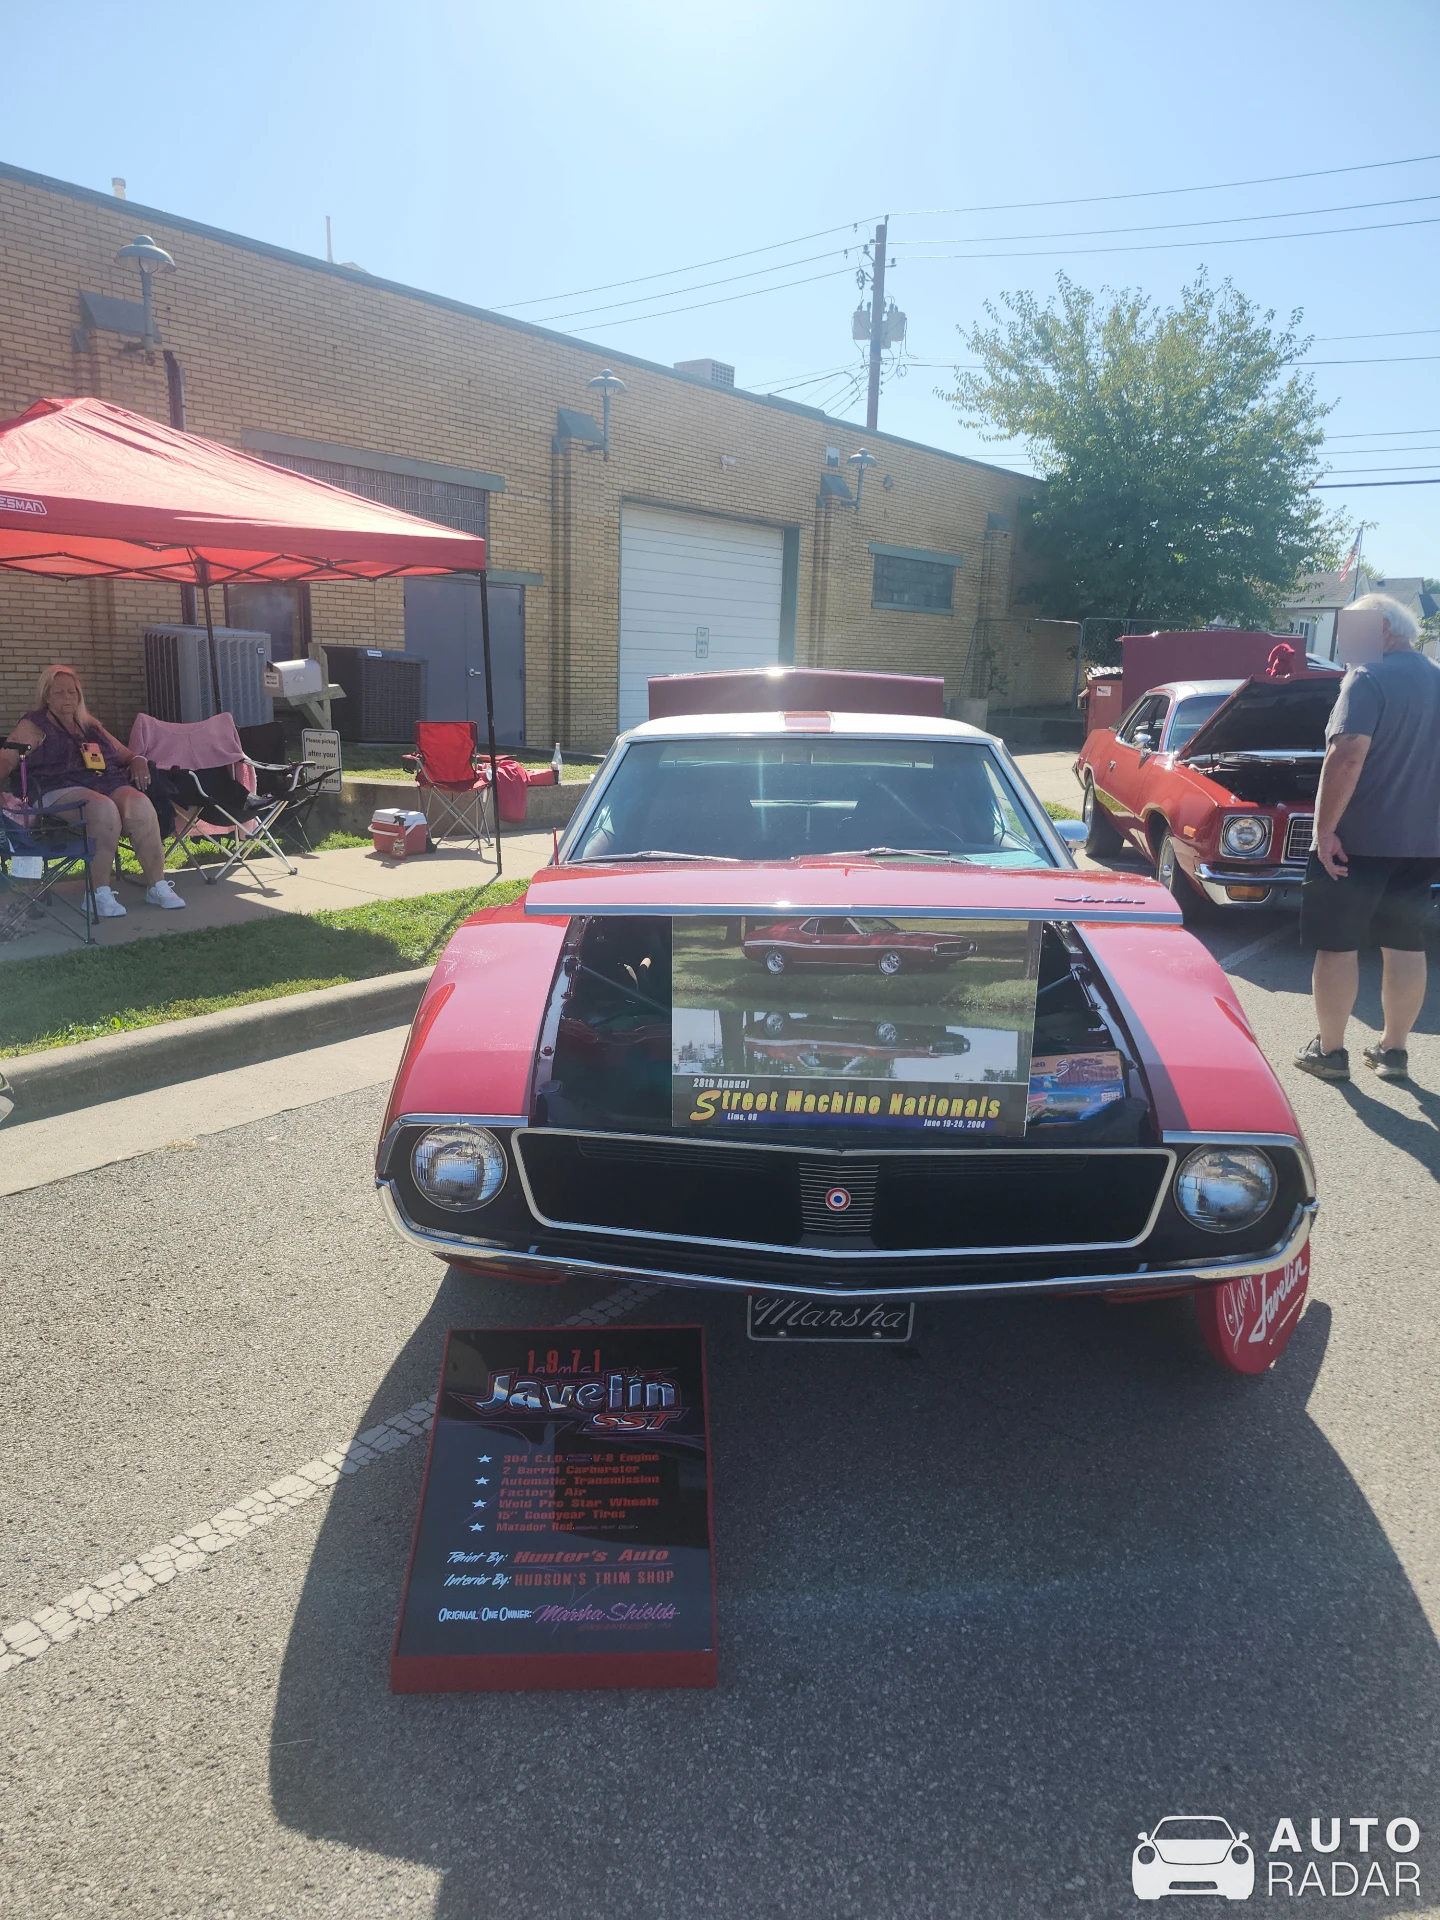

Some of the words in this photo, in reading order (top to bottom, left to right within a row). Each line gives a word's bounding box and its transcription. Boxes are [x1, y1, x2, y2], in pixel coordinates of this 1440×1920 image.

[322, 738, 336, 746] pickup
[692, 1078, 714, 1088] 28th
[716, 1078, 750, 1089] Annual
[689, 1090, 778, 1121] Street
[785, 1090, 881, 1115] Machine
[888, 1093, 1000, 1119] Nationals
[924, 1118, 941, 1128] June
[942, 1120, 965, 1129] 19-20,
[966, 1120, 986, 1129] 2004
[1248, 1256, 1308, 1344] Javelin
[754, 1297, 906, 1328] Marsha
[527, 1350, 600, 1373] 1971
[475, 1374, 676, 1410] Javelin
[588, 1412, 681, 1432] SST
[504, 1454, 528, 1463] 304
[592, 1454, 614, 1462] V-8
[620, 1453, 660, 1462] Engine
[502, 1466, 510, 1474] 2
[518, 1466, 560, 1474] Barrel
[500, 1477, 566, 1486] Automatic
[574, 1476, 660, 1484] Transmission
[500, 1488, 556, 1498] Factory
[564, 1488, 587, 1496] Air
[498, 1499, 532, 1508] Weld
[539, 1500, 564, 1508] Pro
[570, 1499, 602, 1508] Star
[609, 1498, 659, 1507] Wheels
[524, 1511, 586, 1520] Goodyear
[592, 1510, 626, 1518] Tires
[496, 1522, 546, 1532] Matador
[446, 1552, 486, 1563] Paint
[486, 1552, 508, 1567] By:
[513, 1550, 608, 1563] Hunter's
[618, 1549, 669, 1562] Auto
[444, 1573, 492, 1587] Interior
[492, 1574, 512, 1590] By:
[514, 1573, 586, 1586] HUDSON'S
[596, 1572, 630, 1584] TRIM
[638, 1570, 674, 1584] SHOP
[438, 1608, 478, 1622] ORIGINAL
[481, 1607, 498, 1622] ONE
[532, 1604, 606, 1624] Marsha
[606, 1602, 680, 1621] Shields
